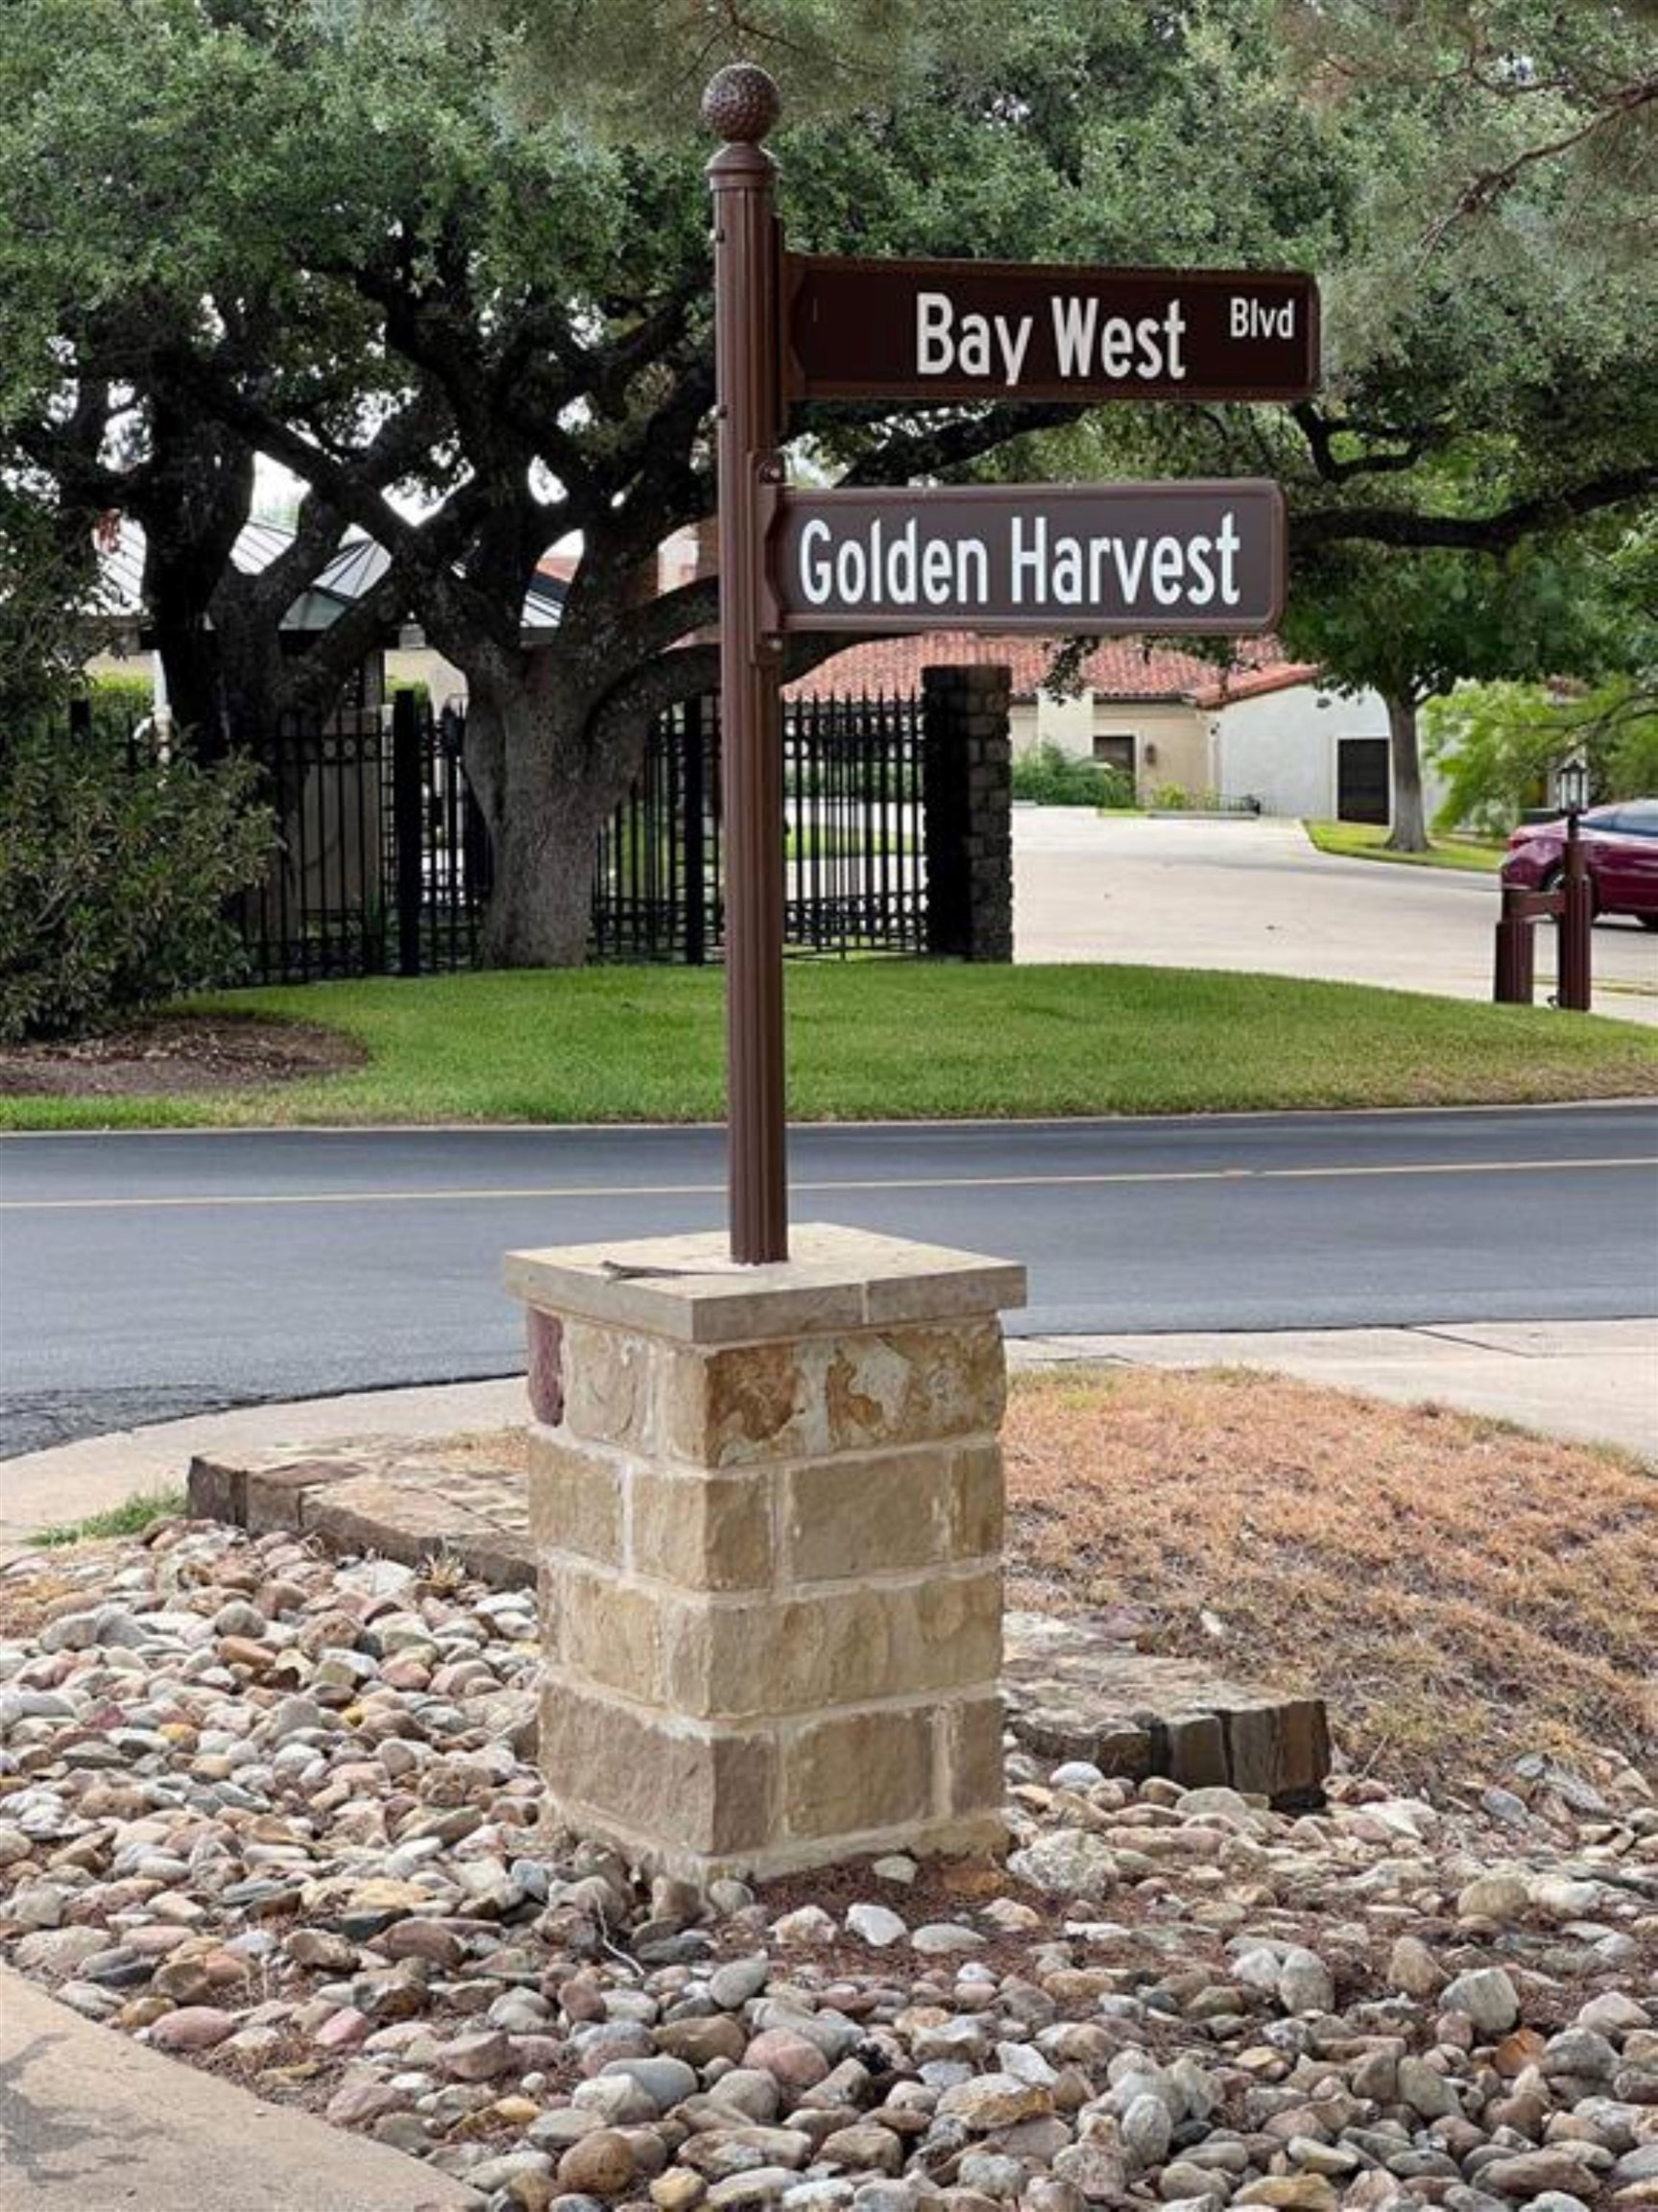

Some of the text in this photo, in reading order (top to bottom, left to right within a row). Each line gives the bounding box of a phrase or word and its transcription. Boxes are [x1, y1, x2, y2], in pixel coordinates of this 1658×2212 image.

[917, 293, 1295, 386] Bay West Blvd
[800, 512, 1240, 606] Golden Harvest
